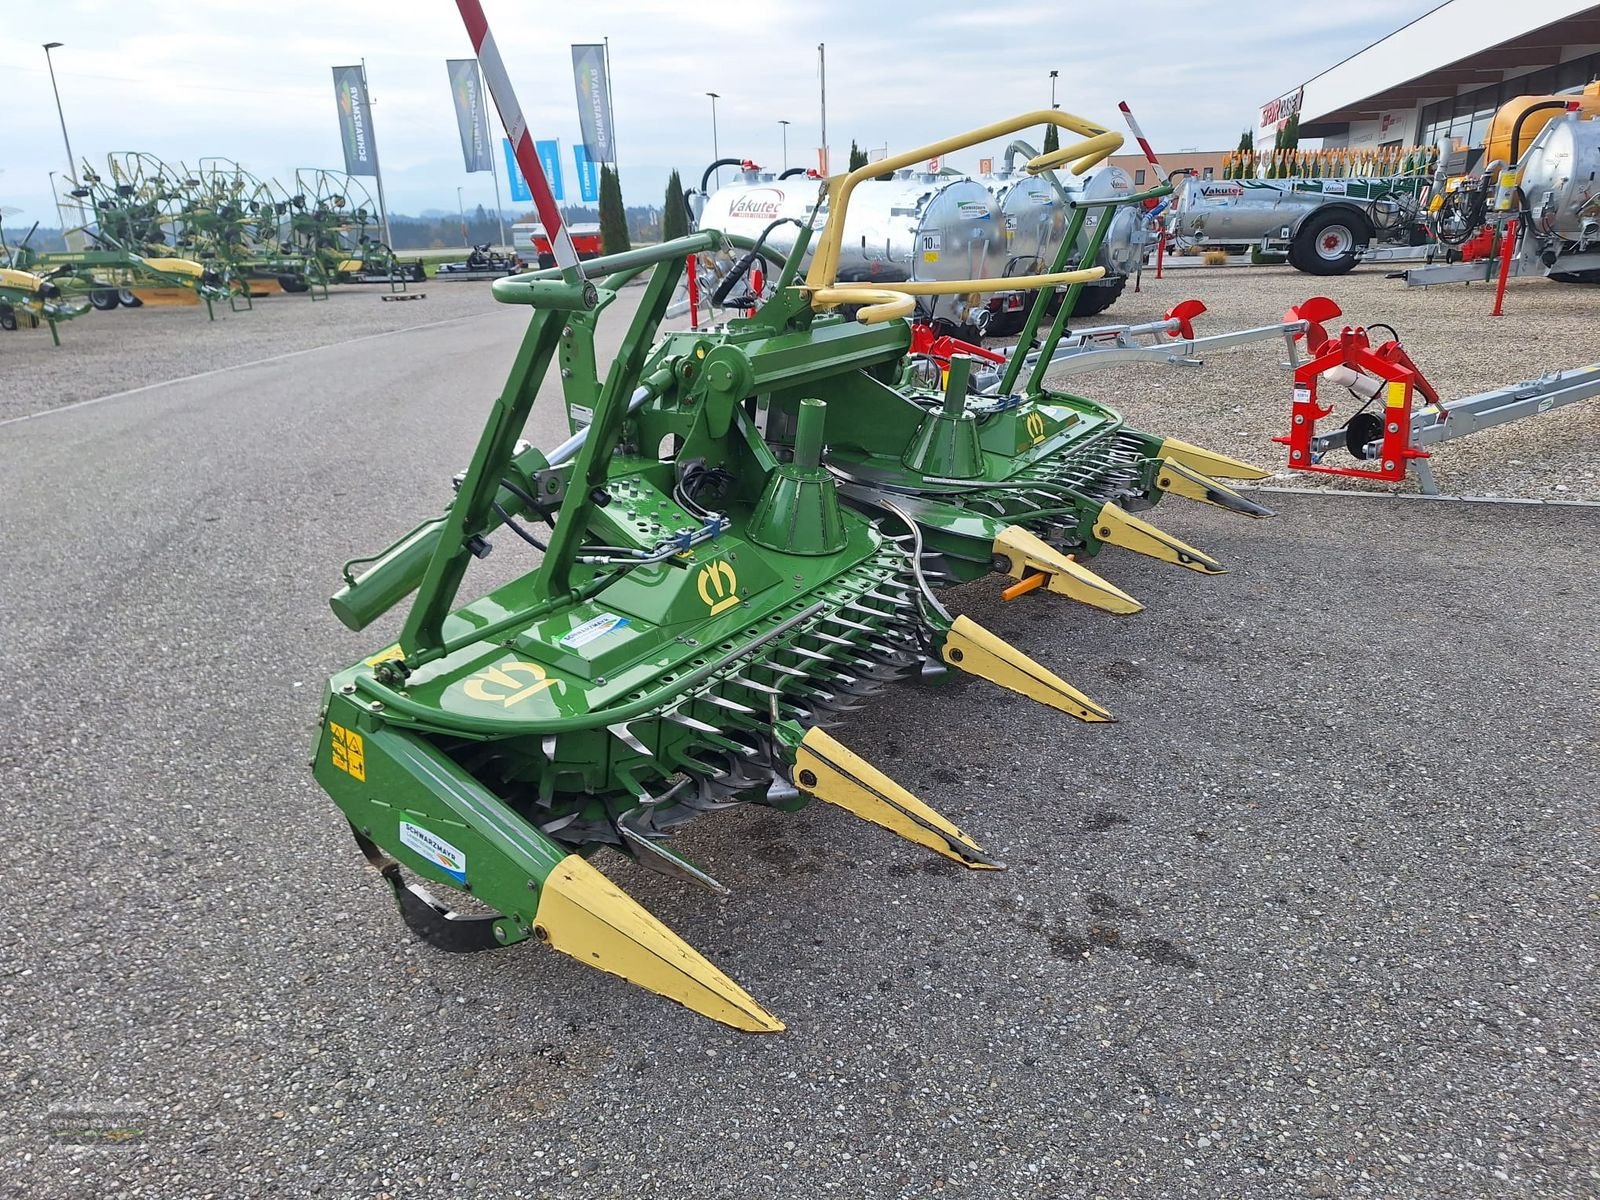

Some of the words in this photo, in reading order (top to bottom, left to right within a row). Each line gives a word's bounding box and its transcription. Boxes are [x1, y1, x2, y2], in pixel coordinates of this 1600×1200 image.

[1200, 186, 1244, 196] Vakutec
[728, 195, 782, 217] Vakutec
[923, 236, 933, 250] 10
[405, 823, 456, 861] SCHWARZMAYR
